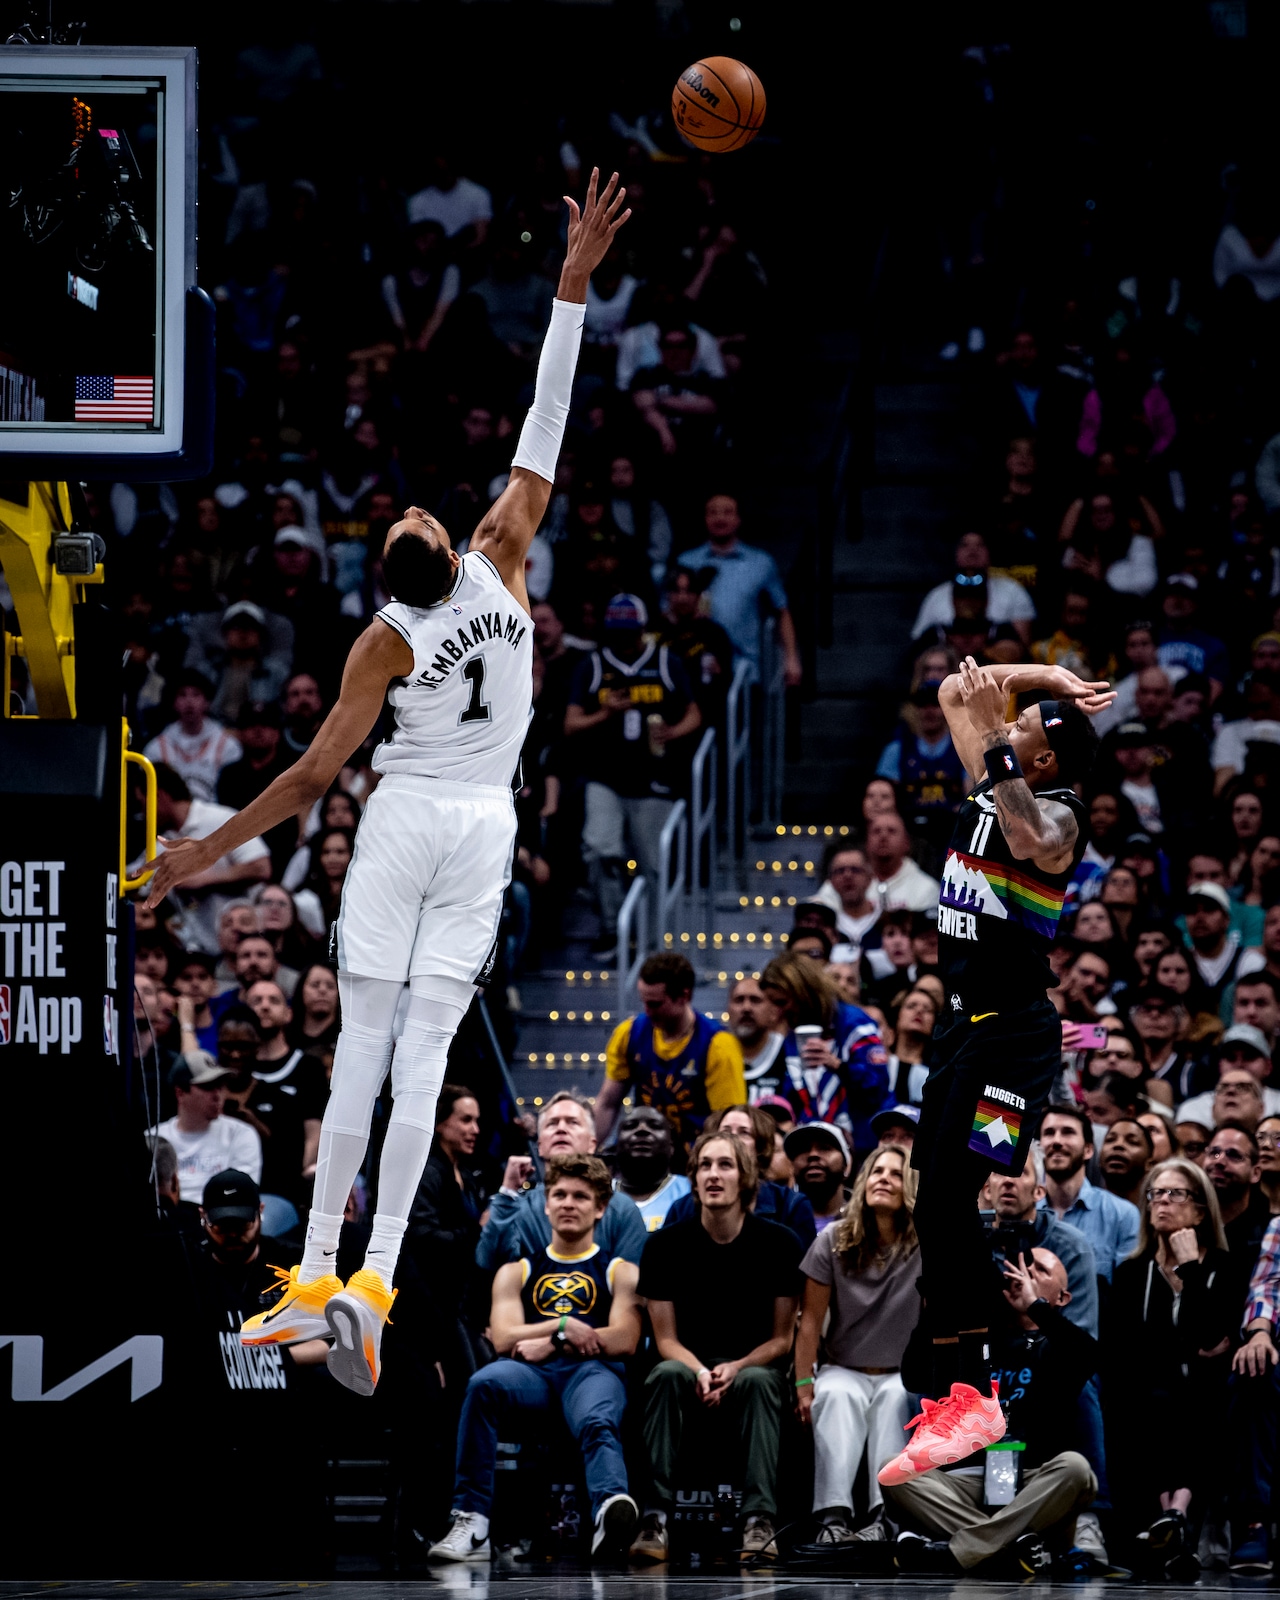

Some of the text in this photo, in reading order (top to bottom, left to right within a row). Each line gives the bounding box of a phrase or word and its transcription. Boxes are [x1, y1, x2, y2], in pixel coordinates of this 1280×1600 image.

[458, 654, 492, 726] 1
[968, 812, 994, 857] 11
[0, 861, 65, 917] GET
[0, 922, 66, 977] THE
[938, 904, 979, 941] ENVER
[15, 985, 82, 1055] App
[983, 1084, 1026, 1111] NUGGETS
